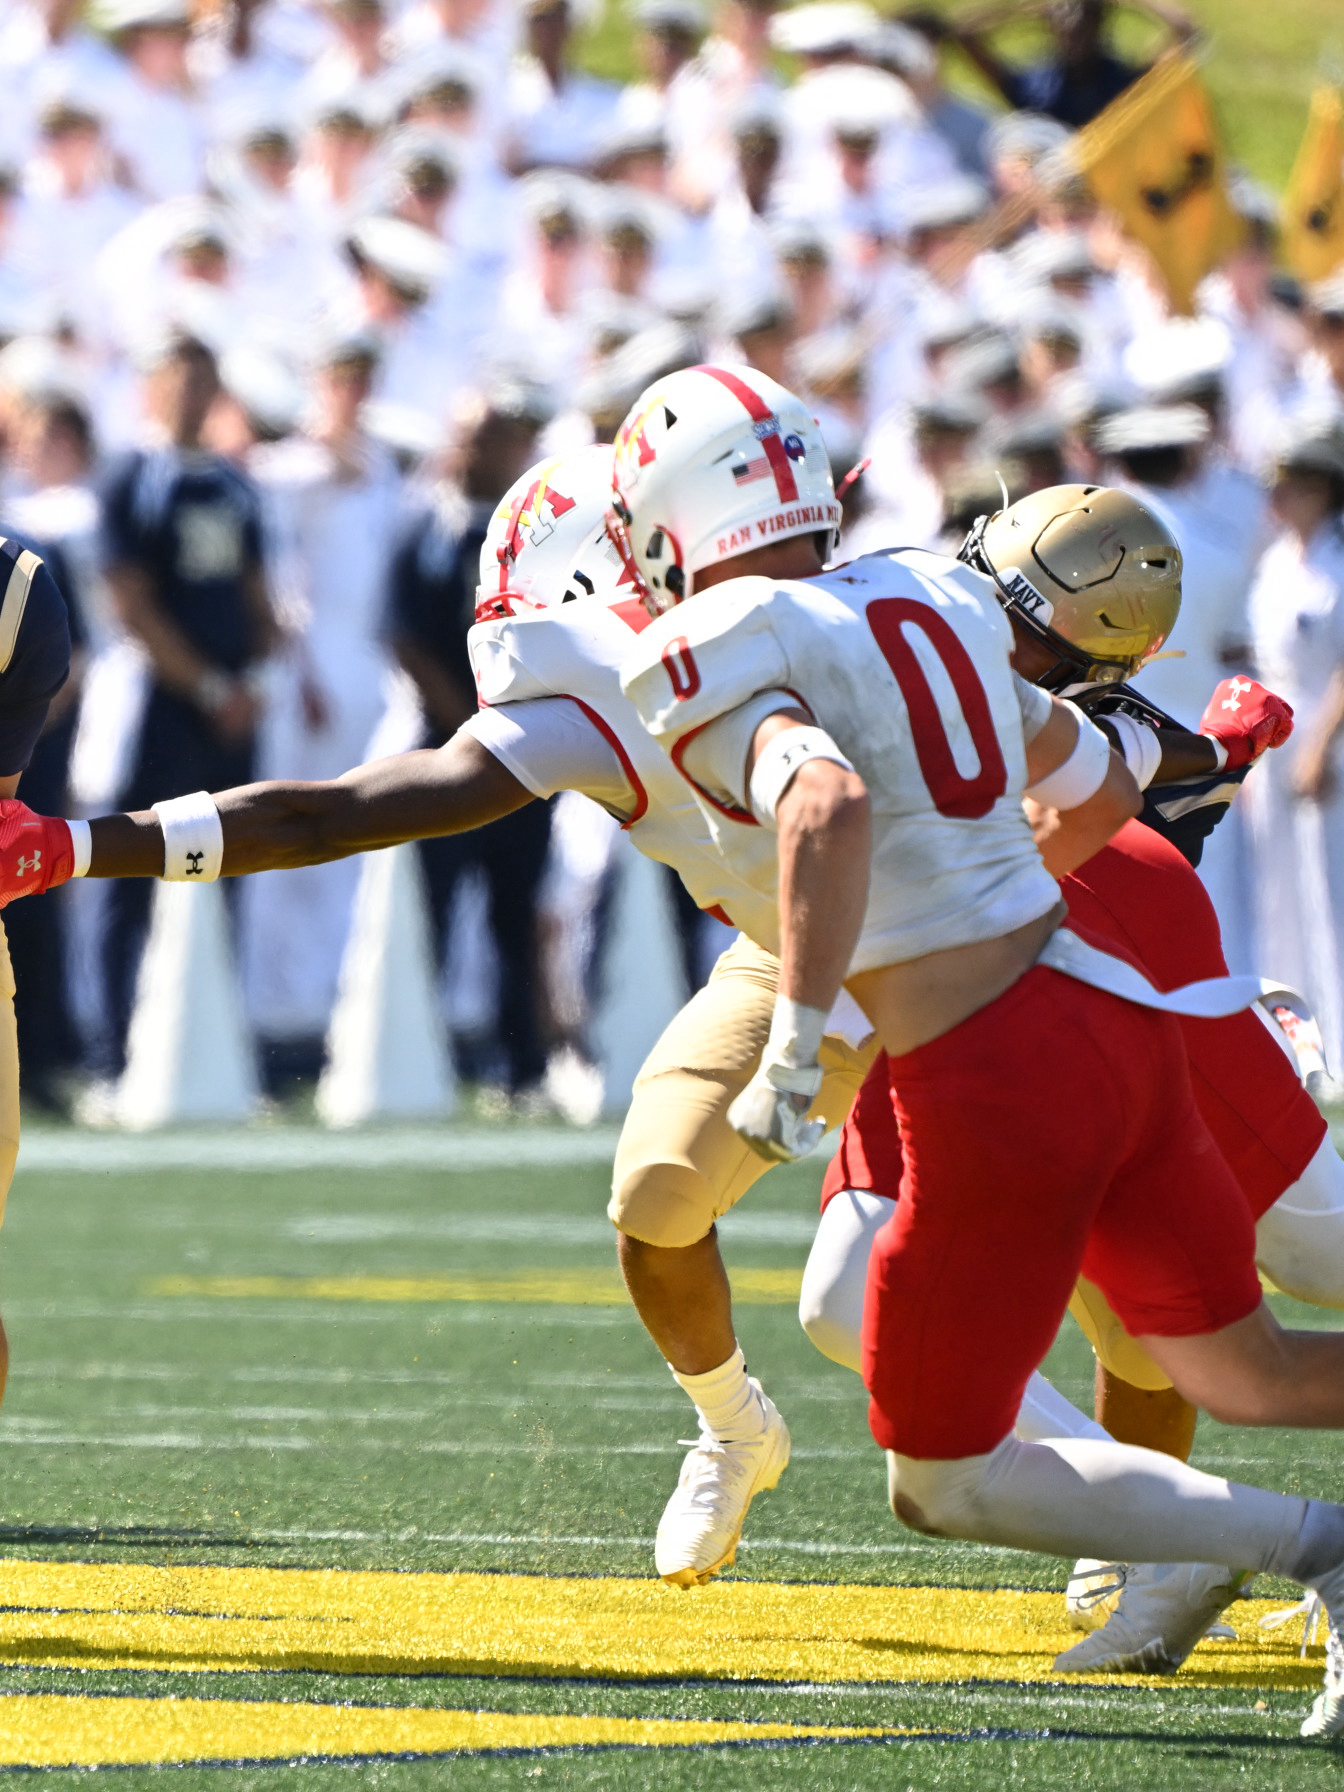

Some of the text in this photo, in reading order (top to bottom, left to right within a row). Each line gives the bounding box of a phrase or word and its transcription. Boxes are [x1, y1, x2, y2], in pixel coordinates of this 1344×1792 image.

[757, 506, 824, 536] VIRGINIA
[1006, 574, 1045, 613] NAVY
[661, 636, 701, 701] 0
[866, 598, 1007, 818] 0
